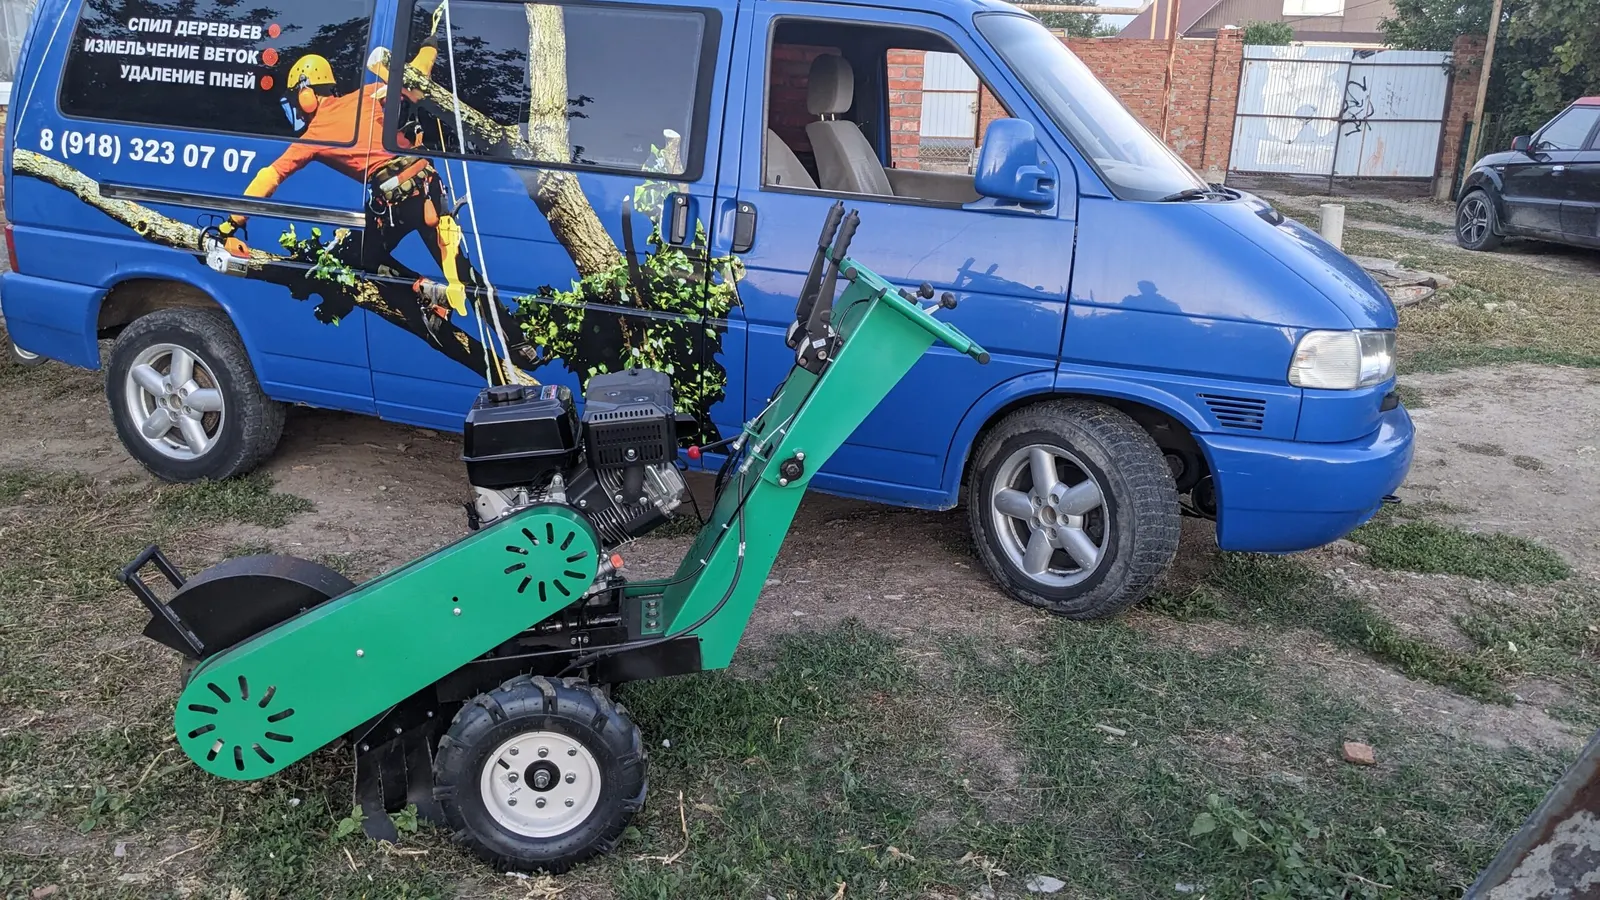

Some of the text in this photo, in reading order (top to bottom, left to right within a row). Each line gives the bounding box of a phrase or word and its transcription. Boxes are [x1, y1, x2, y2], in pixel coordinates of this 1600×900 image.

[128, 18, 262, 40] СПИЛ ДЕРЕВЬЕВ
[84, 39, 259, 65] ИЗМЕЛЬЧЕНИЕ ВЕТОК
[120, 64, 256, 90] УДАЛЕНИЕ ПНЕЙ
[40, 129, 256, 174] 8 (918) 323 07 07
